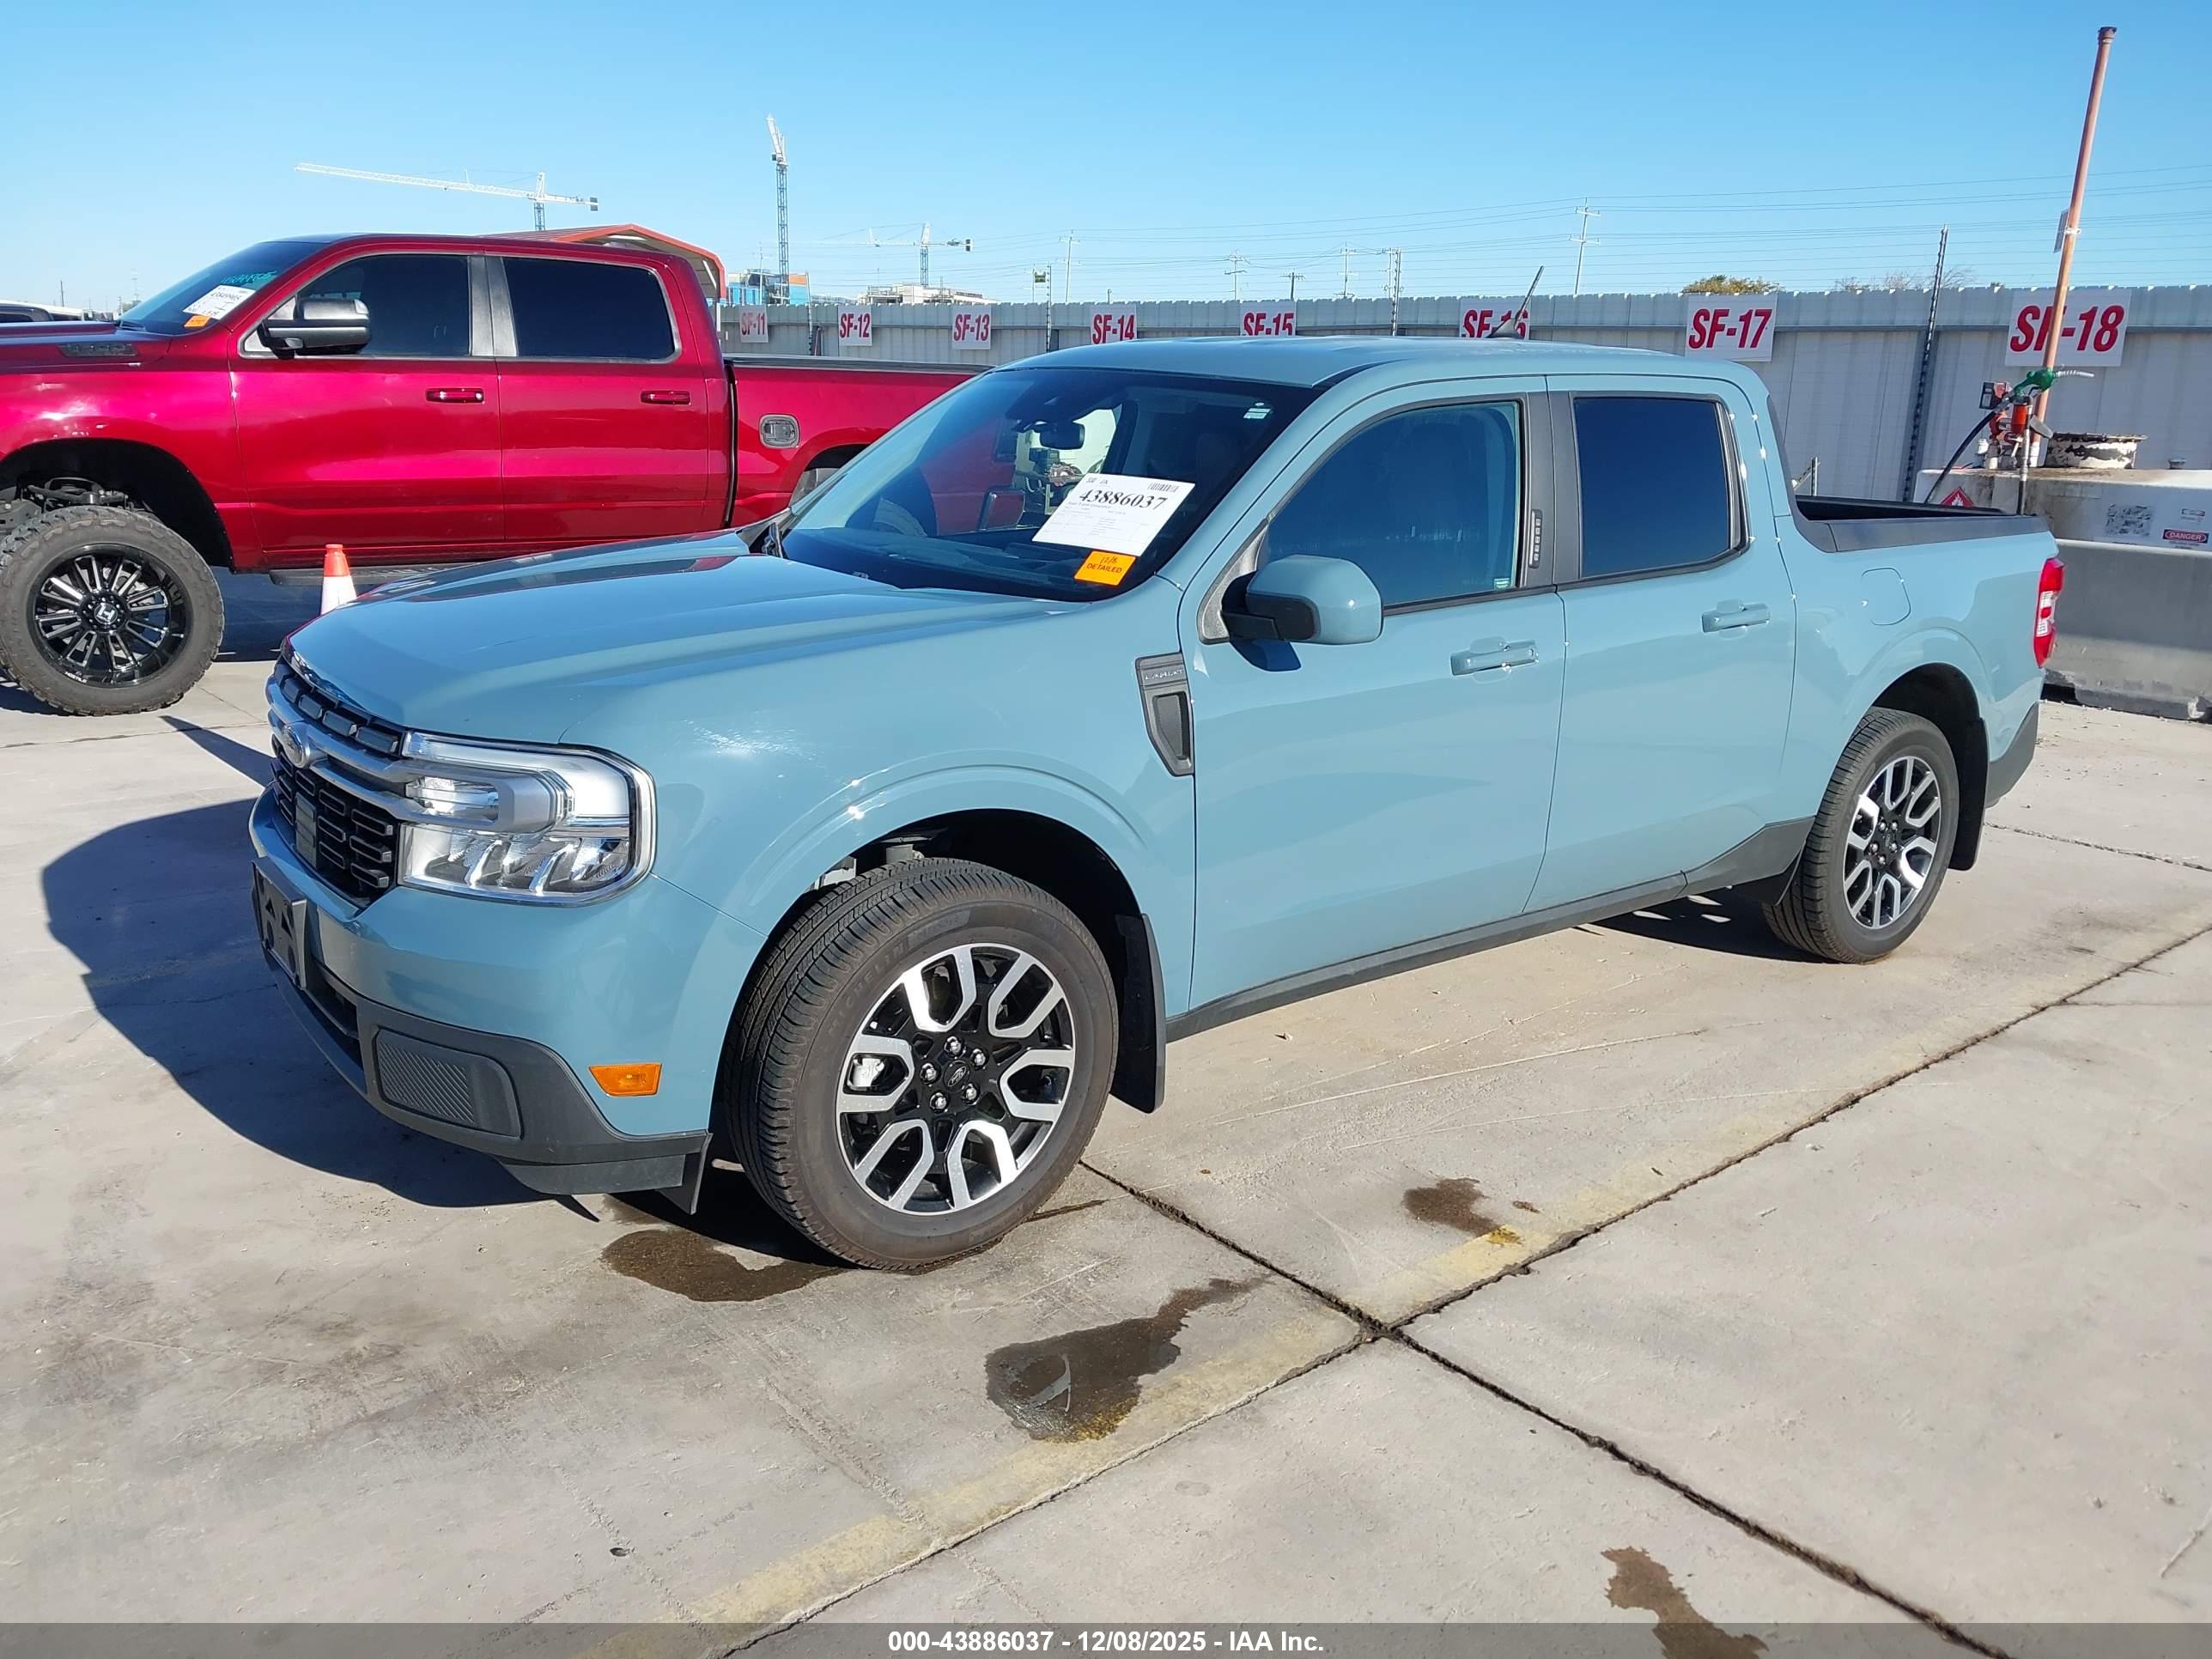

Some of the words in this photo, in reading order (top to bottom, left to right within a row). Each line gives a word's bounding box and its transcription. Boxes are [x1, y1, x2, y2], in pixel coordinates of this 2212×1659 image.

[741, 312, 766, 336] SF-11
[839, 313, 870, 339] SF-12
[953, 313, 990, 342] SF-13
[1092, 314, 1135, 343] SF-14
[1243, 312, 1294, 336] SF-15
[1688, 308, 1773, 349] SF-17
[1079, 489, 1168, 511] 43886037
[2169, 532, 2202, 542] DANGER
[1086, 563, 1122, 573] DETAILED
